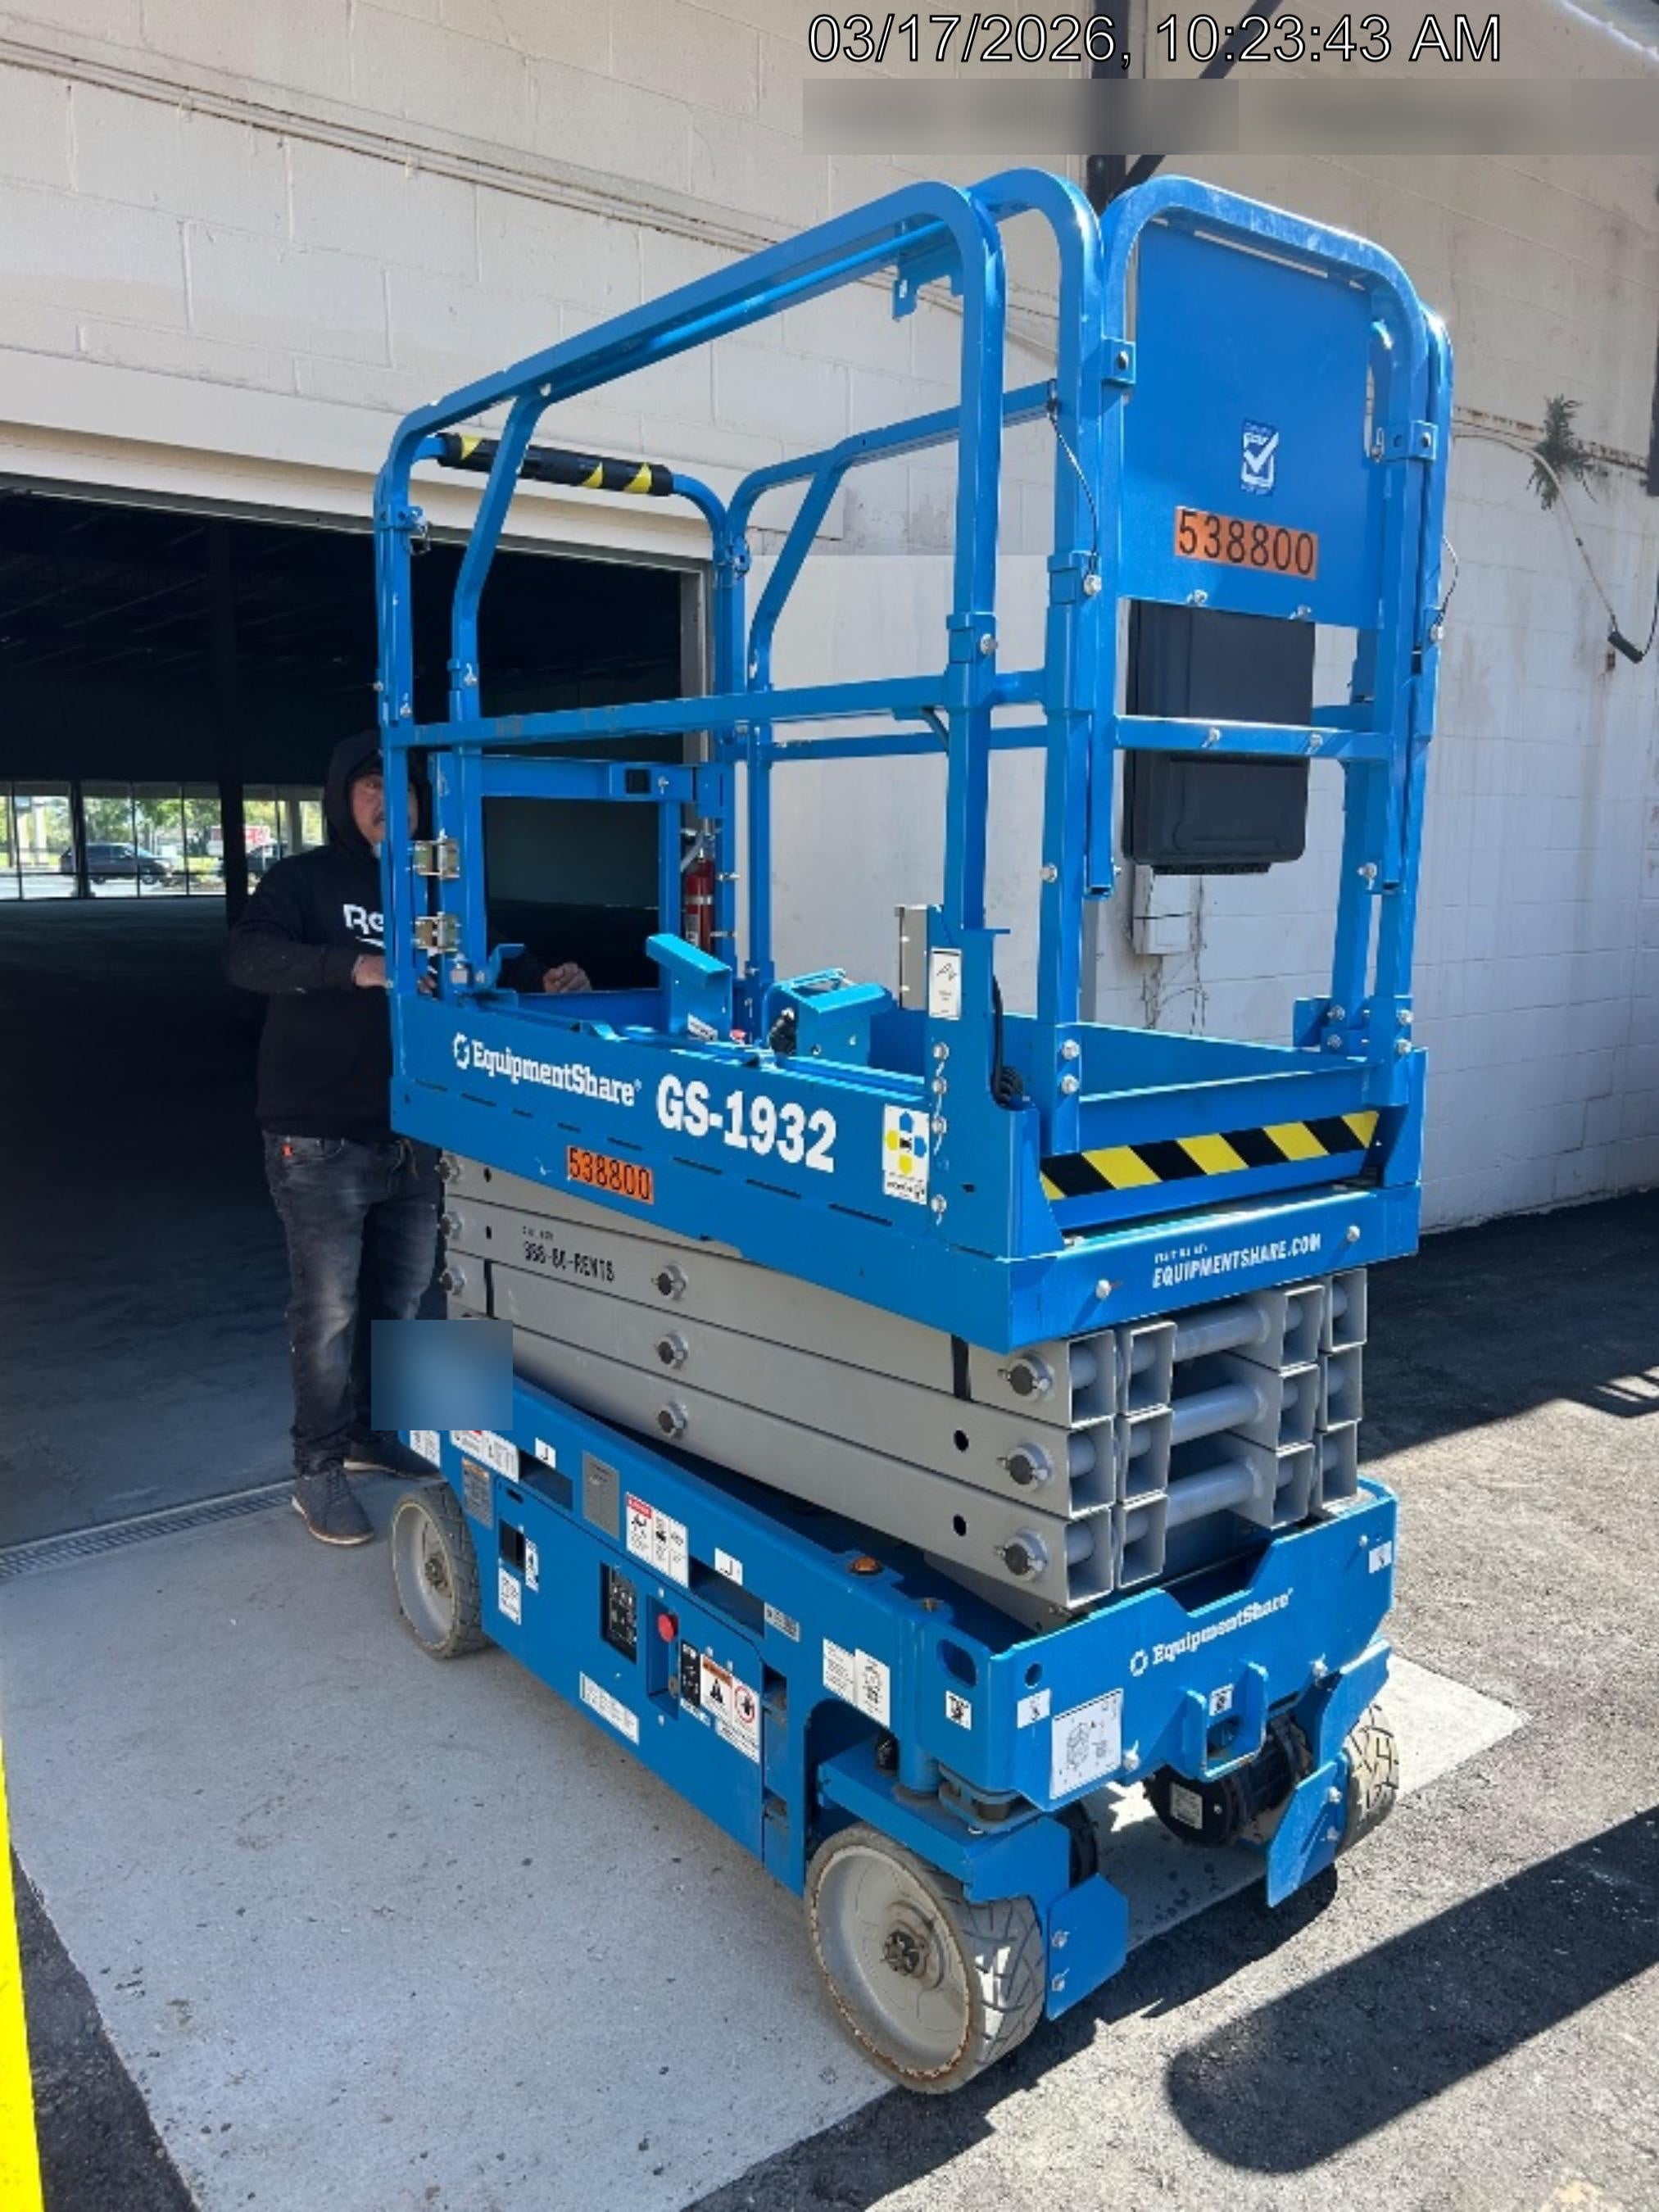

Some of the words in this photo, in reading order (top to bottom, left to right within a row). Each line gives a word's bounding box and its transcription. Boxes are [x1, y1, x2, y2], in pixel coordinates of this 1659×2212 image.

[1177, 509, 1315, 576] 538800
[657, 1073, 836, 1173] GS-1932
[568, 1148, 652, 1200] 538800
[1152, 1233, 1321, 1289] EQUIPMENTSHARE.COM
